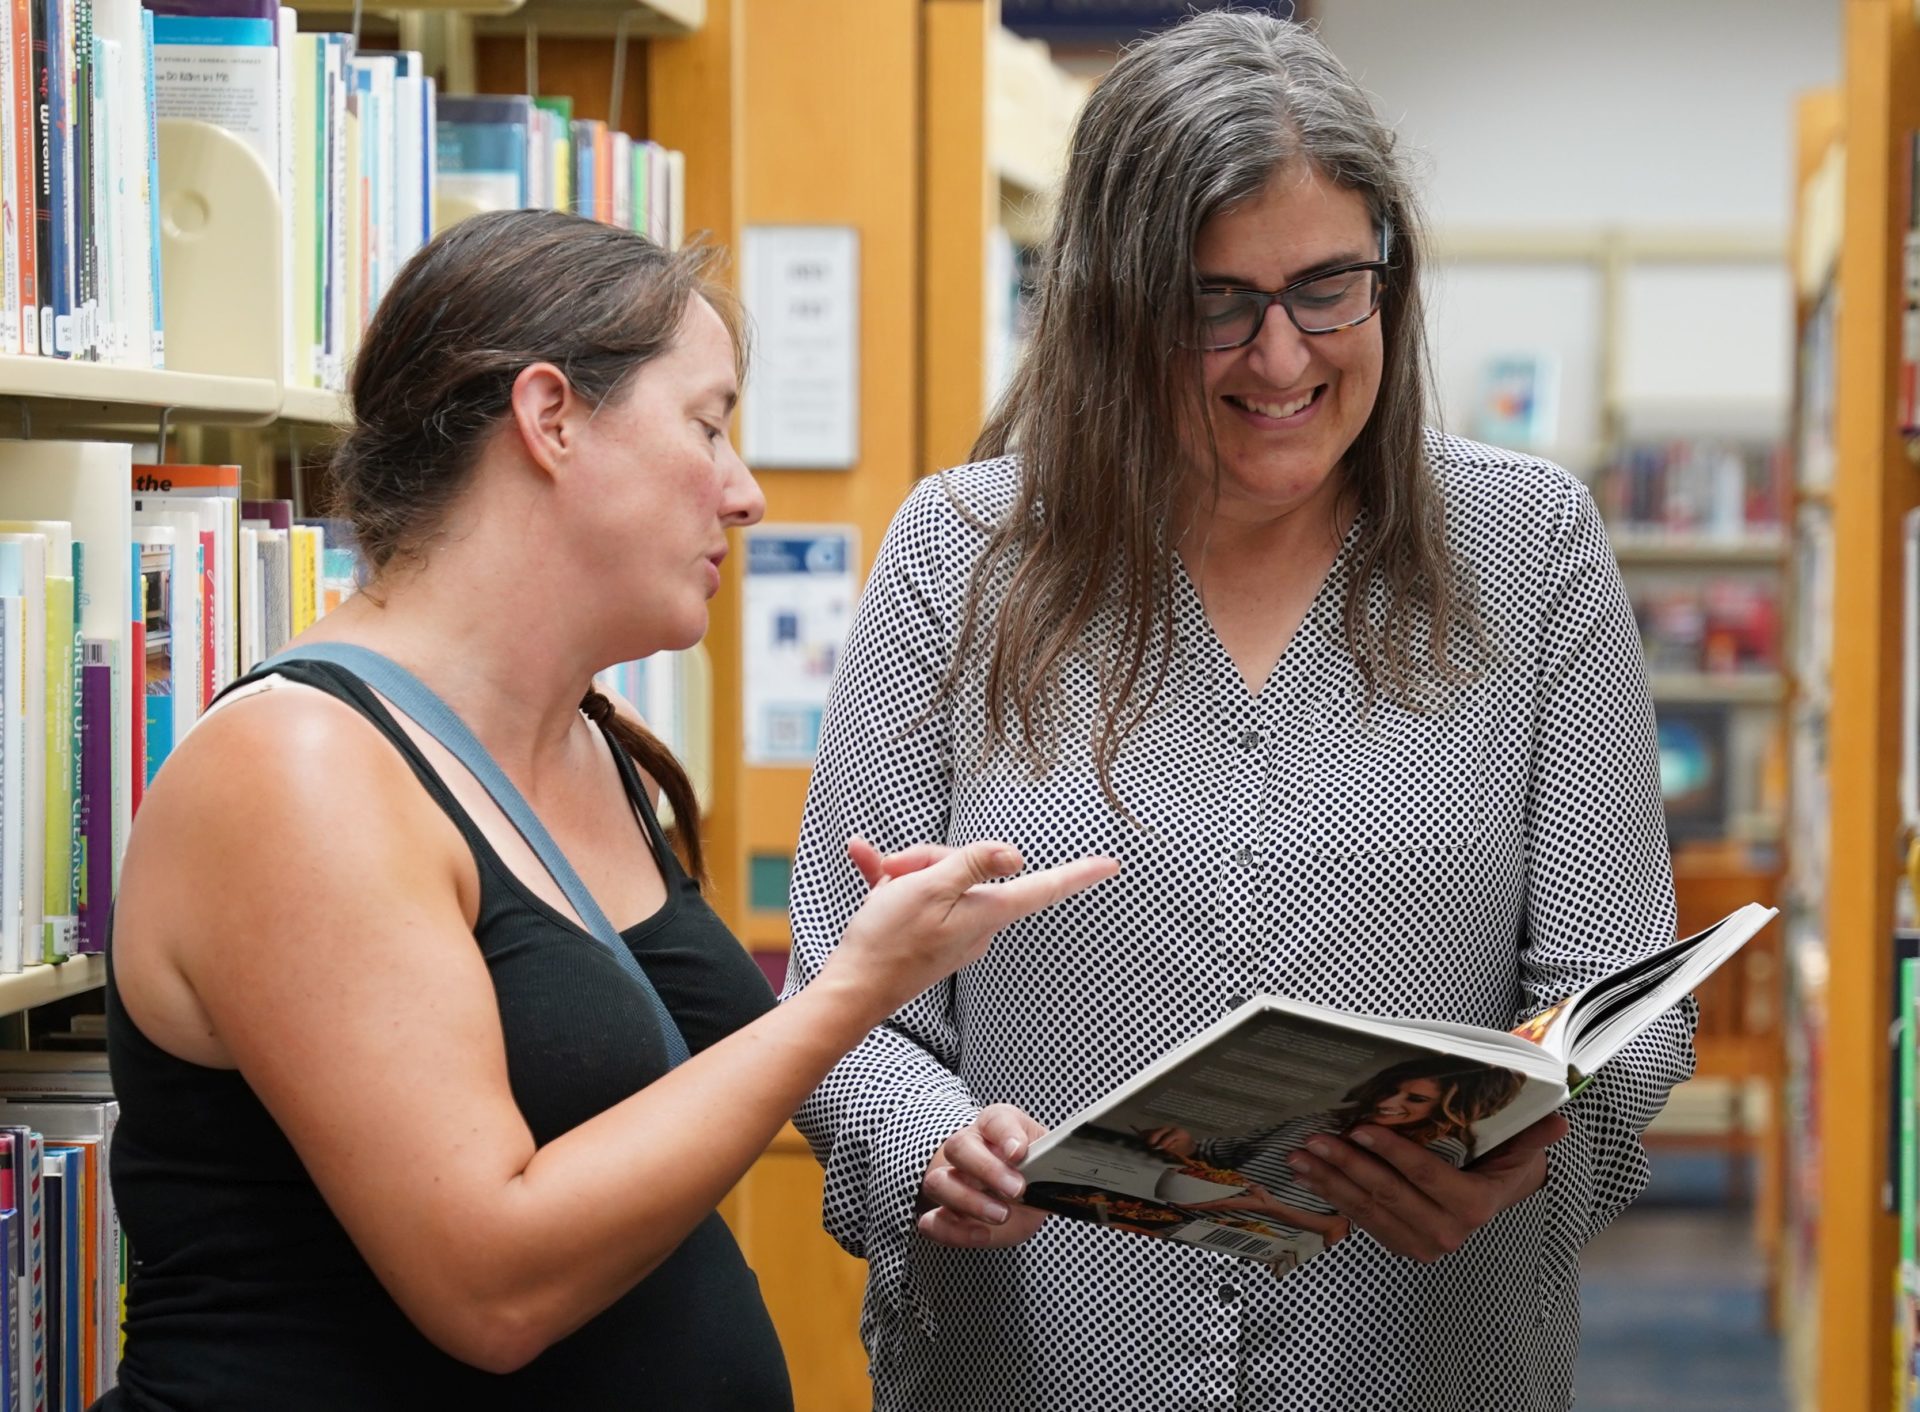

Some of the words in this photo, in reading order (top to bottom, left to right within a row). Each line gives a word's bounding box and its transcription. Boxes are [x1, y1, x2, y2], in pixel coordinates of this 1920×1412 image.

[40, 104, 50, 195] Wisconsin
[136, 475, 172, 492] the
[74, 630, 84, 708] GREEN
[74, 715, 83, 747] UP
[73, 752, 83, 790] your
[9, 1264, 18, 1352] ZERO
